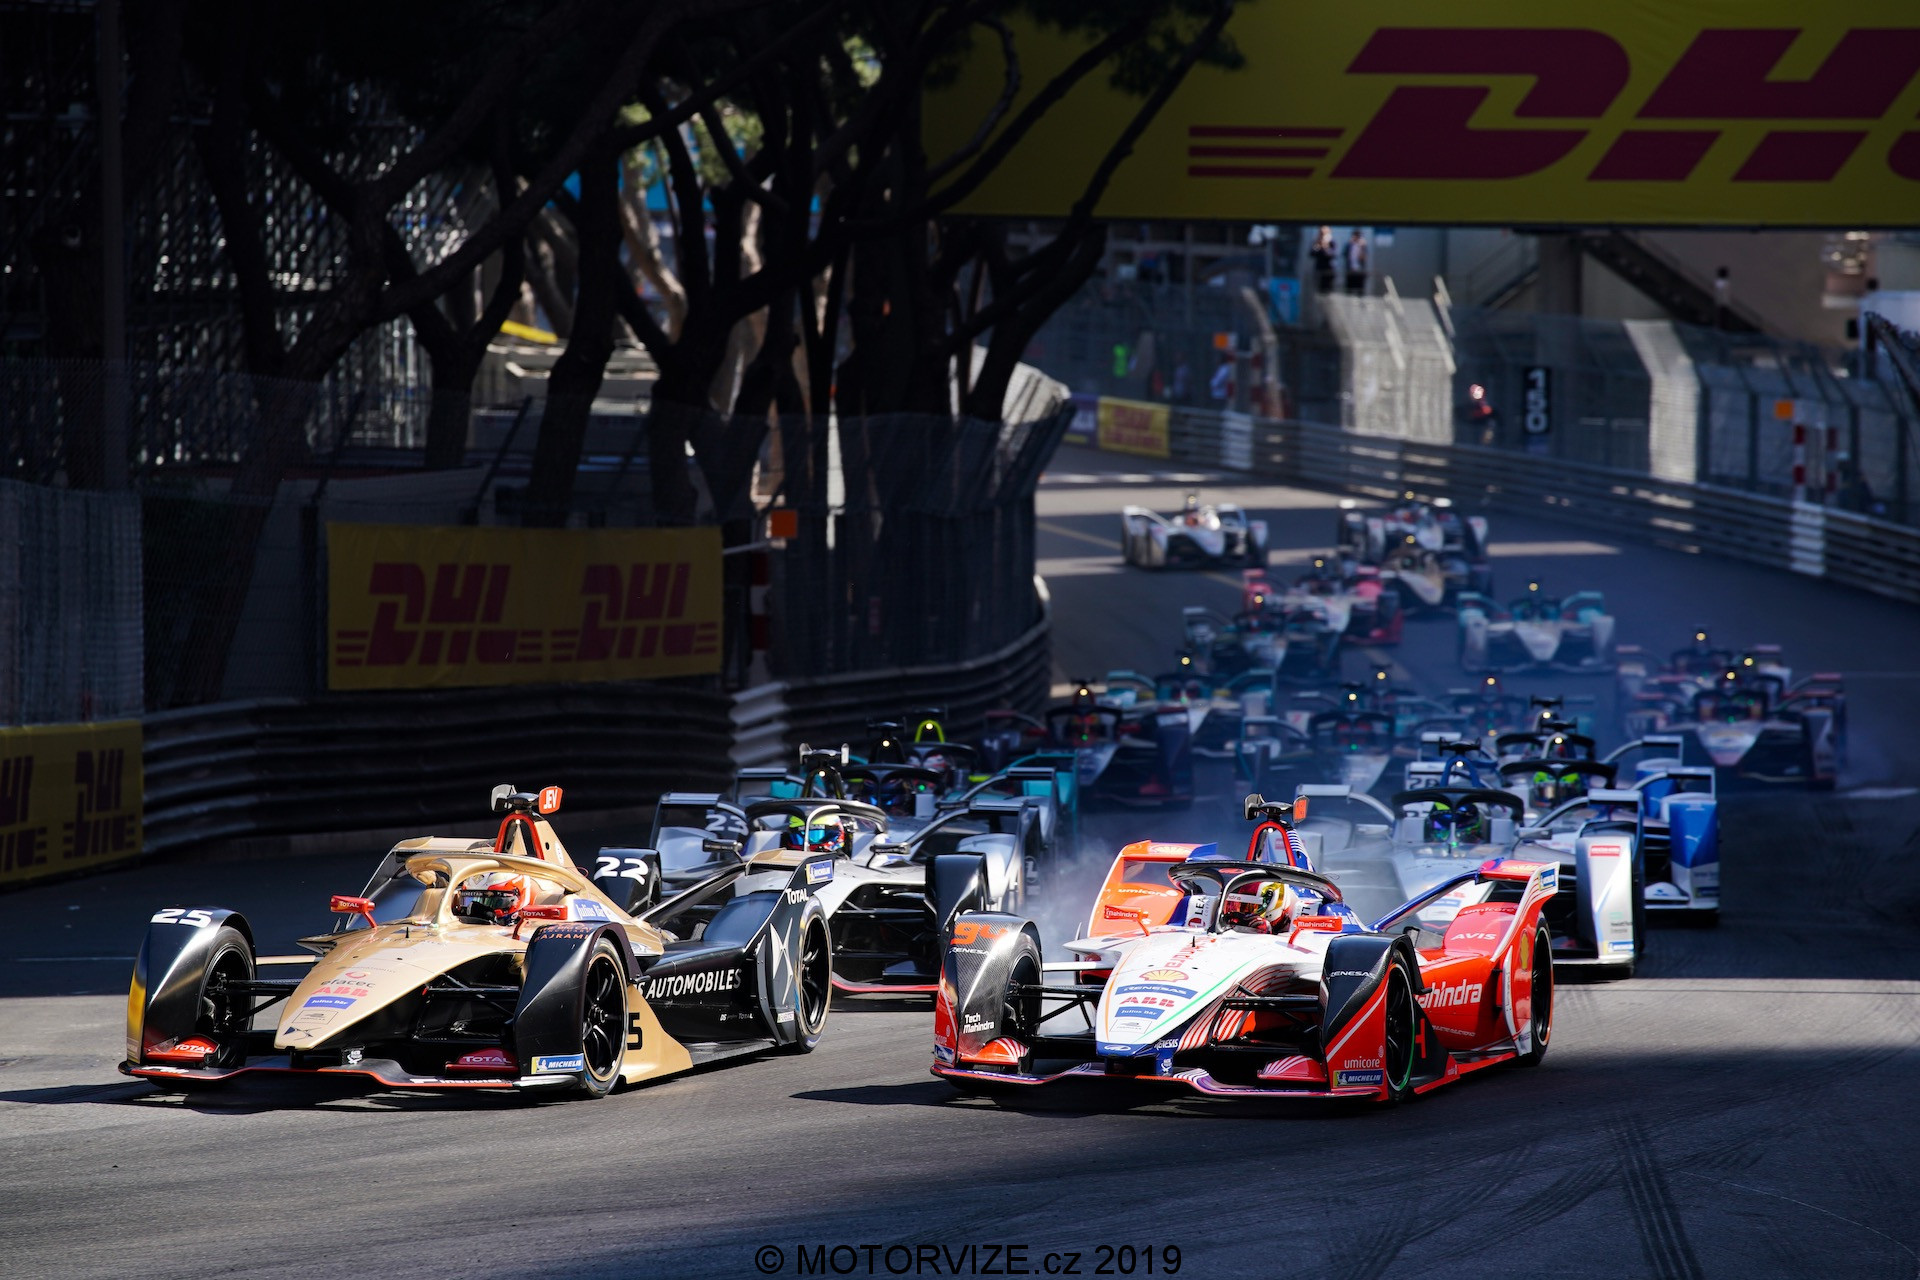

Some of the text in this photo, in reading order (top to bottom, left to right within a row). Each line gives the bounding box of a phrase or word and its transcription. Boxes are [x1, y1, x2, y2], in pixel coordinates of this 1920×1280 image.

[1328, 28, 1920, 182] DH
[365, 562, 696, 666] DHL DHL
[543, 788, 558, 810] JEV
[0, 749, 127, 872] HL DHL
[704, 813, 749, 837] 23
[593, 856, 649, 885] 22
[785, 887, 810, 905] TOTAL
[338, 900, 360, 909] TOTAL
[150, 908, 214, 929] 25
[1450, 933, 1497, 941] AVIS
[320, 978, 376, 988] efacec
[645, 968, 742, 1000] AUTOMOBILES
[311, 985, 369, 998] ABB
[1124, 984, 1188, 996] RENESAS
[1120, 996, 1175, 1008] ABB
[964, 1012, 982, 1024] Tech
[174, 1043, 214, 1054] TOTAL
[462, 1055, 512, 1065] TOTAL
[1344, 1056, 1380, 1069] umicore
[1348, 1073, 1382, 1083] MICHELIN
